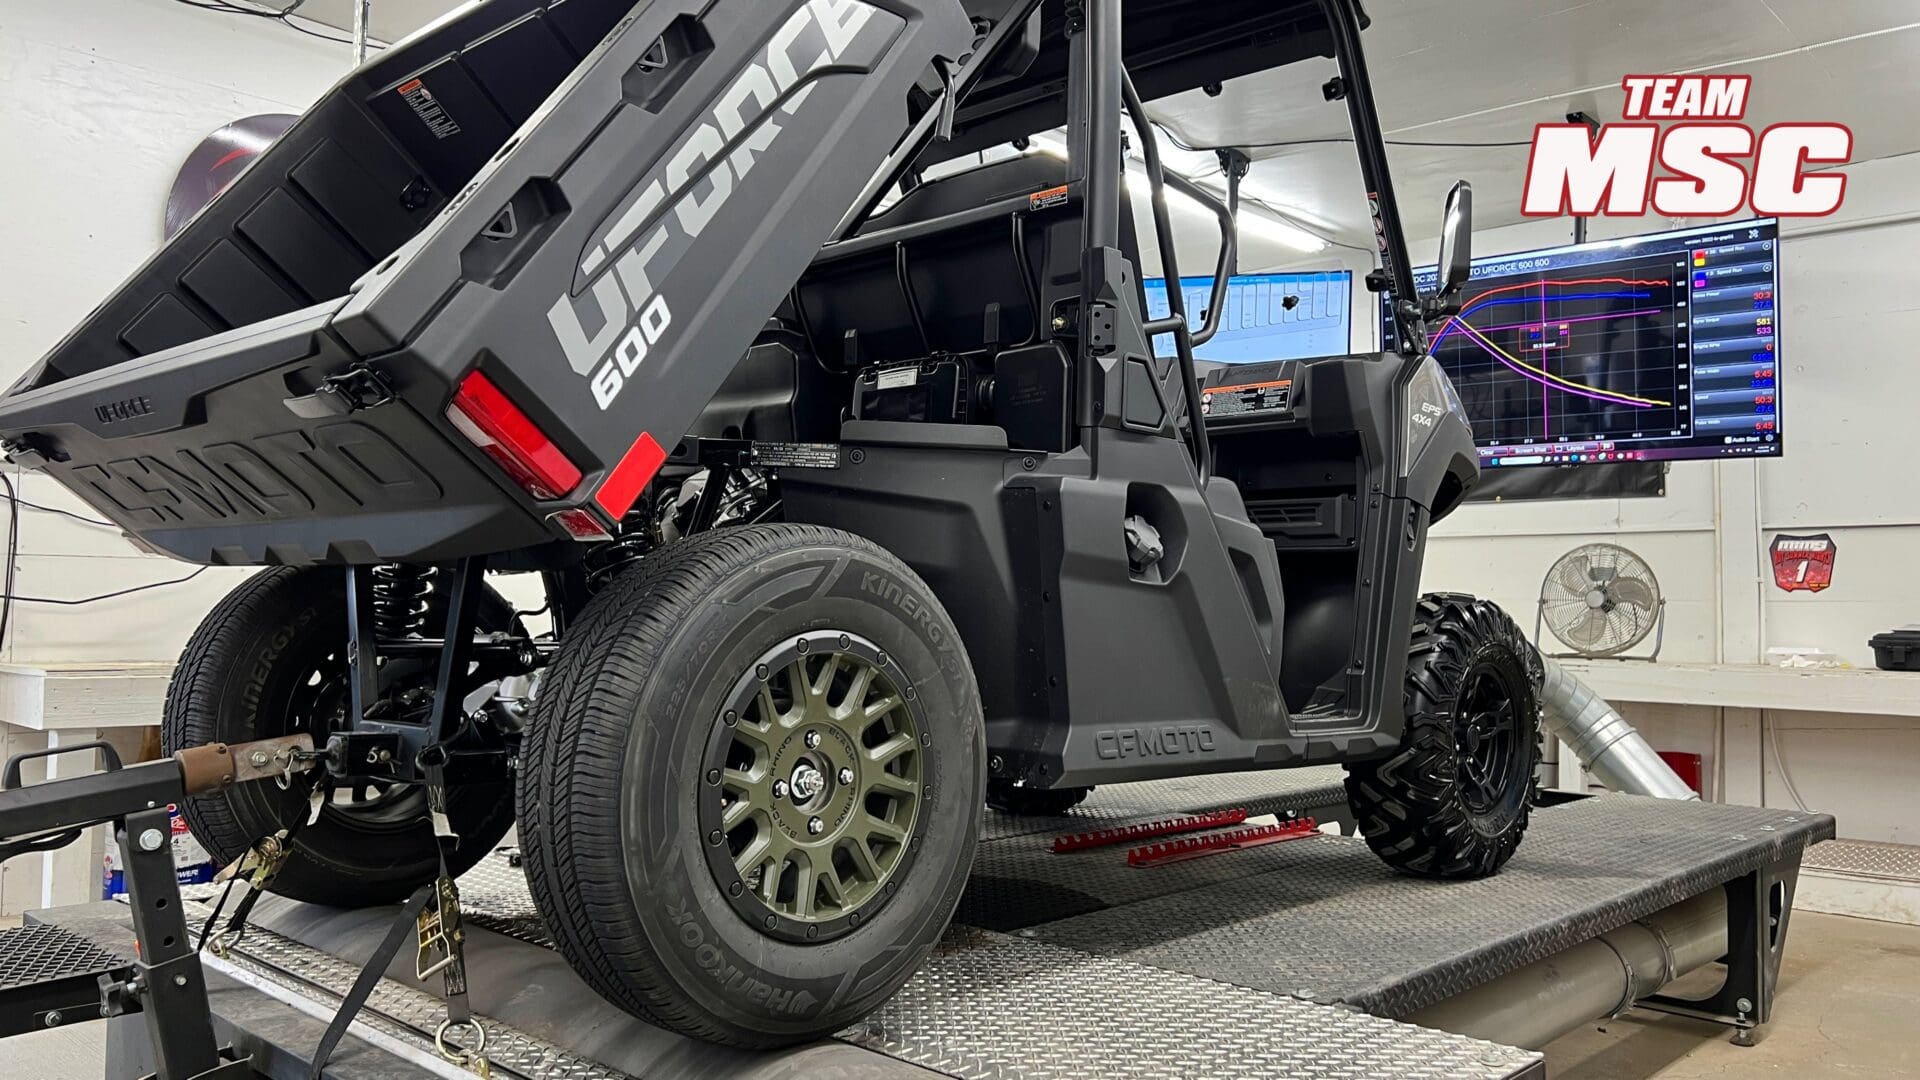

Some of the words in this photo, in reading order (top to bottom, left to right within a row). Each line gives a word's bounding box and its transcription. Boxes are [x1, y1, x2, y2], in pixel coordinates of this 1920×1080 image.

[547, 0, 876, 376] UFORCE
[1482, 263, 1517, 274] UFORCE
[1518, 260, 1533, 269] 600
[1534, 258, 1550, 267] 600
[1756, 327, 1772, 335] 533
[590, 294, 672, 410] 600
[1411, 413, 1432, 428] 4X4
[1421, 402, 1442, 416] EPS
[72, 421, 443, 521] CFMOTO
[1795, 559, 1809, 583] 1
[1096, 724, 1216, 760] CFMOTO
